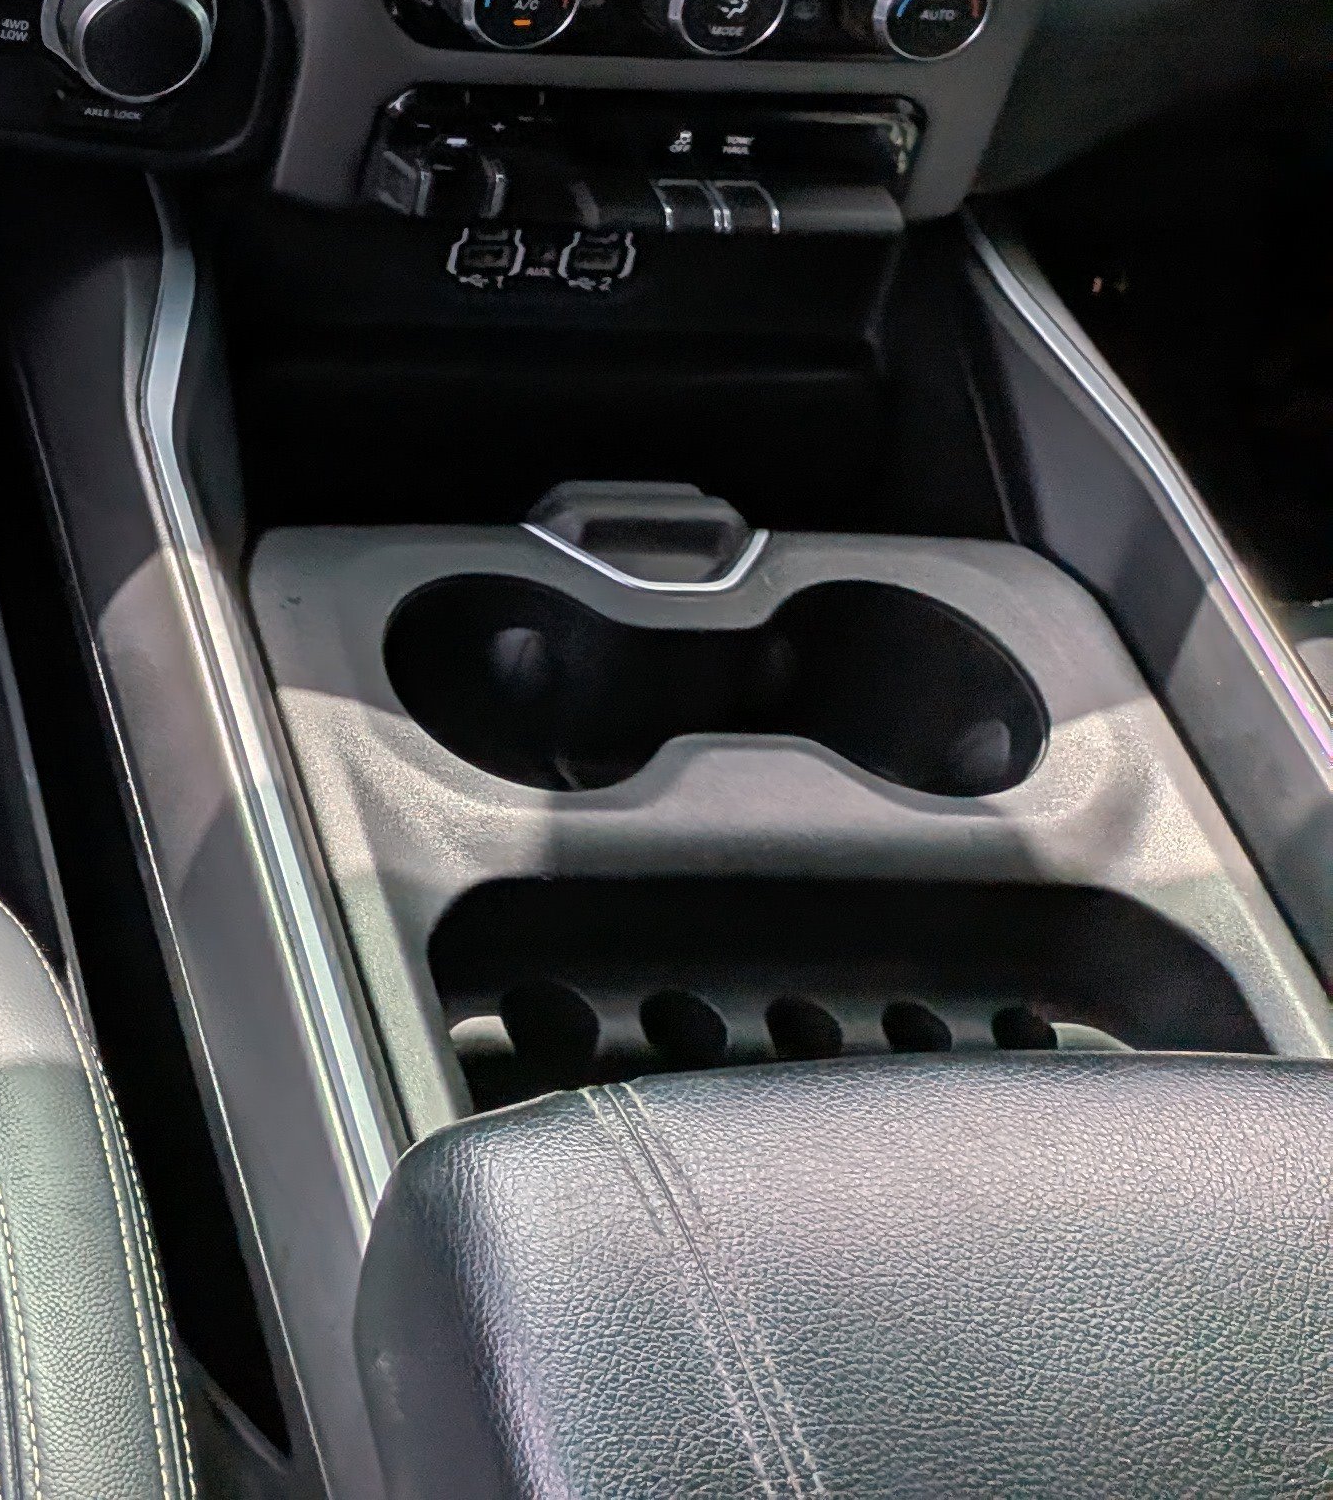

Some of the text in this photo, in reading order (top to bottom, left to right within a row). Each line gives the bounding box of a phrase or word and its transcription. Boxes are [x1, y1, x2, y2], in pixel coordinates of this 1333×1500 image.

[513, 0, 541, 11] A/C
[918, 9, 957, 22] AUTO
[1, 18, 30, 31] 4WD
[0, 28, 30, 42] LOW
